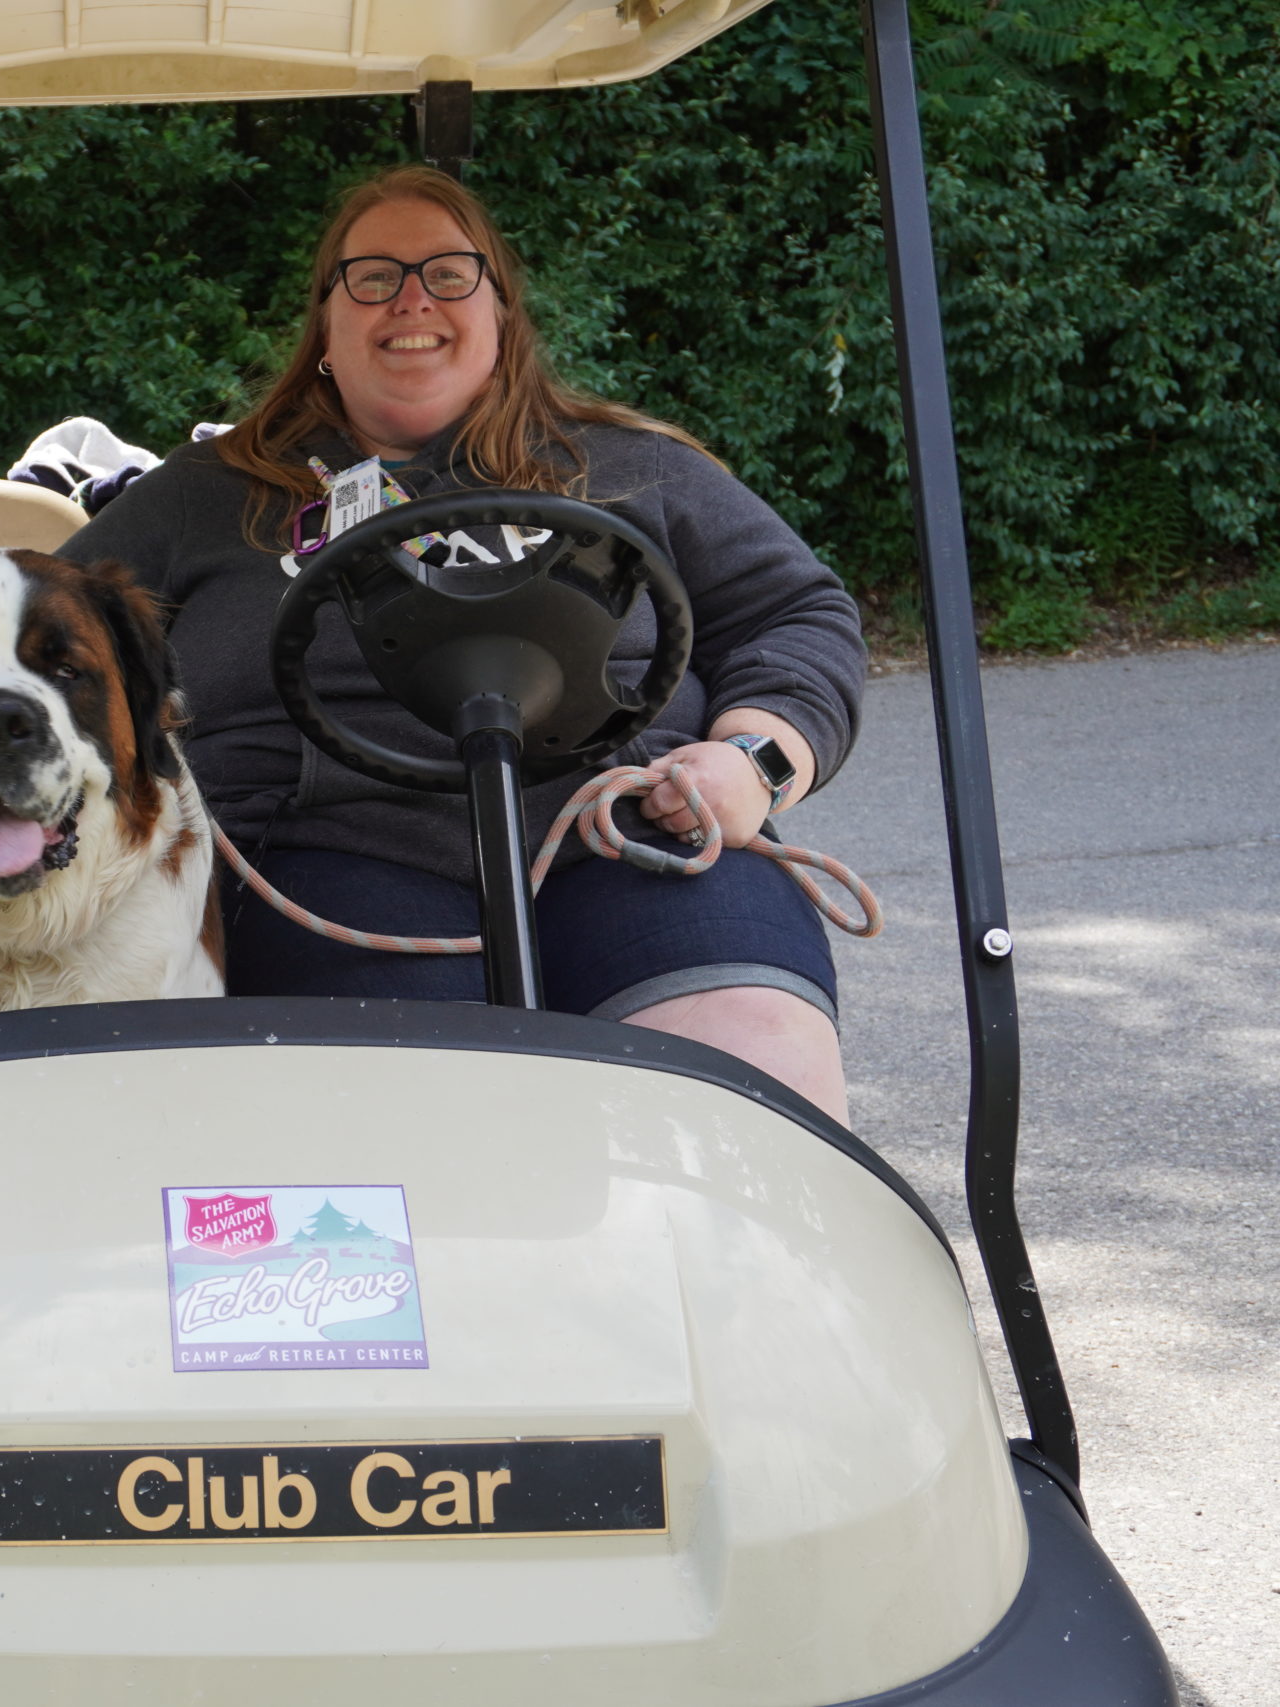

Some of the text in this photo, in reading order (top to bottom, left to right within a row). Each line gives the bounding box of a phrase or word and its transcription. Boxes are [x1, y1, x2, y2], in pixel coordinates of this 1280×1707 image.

[191, 1202, 267, 1242] SALVATION
[201, 1198, 236, 1220] THE
[221, 1220, 265, 1250] ARMY
[180, 1257, 412, 1333] Echo Grove
[180, 1345, 424, 1364] CAMP and RETREAT CENTER
[117, 1451, 512, 1532] Club Car
